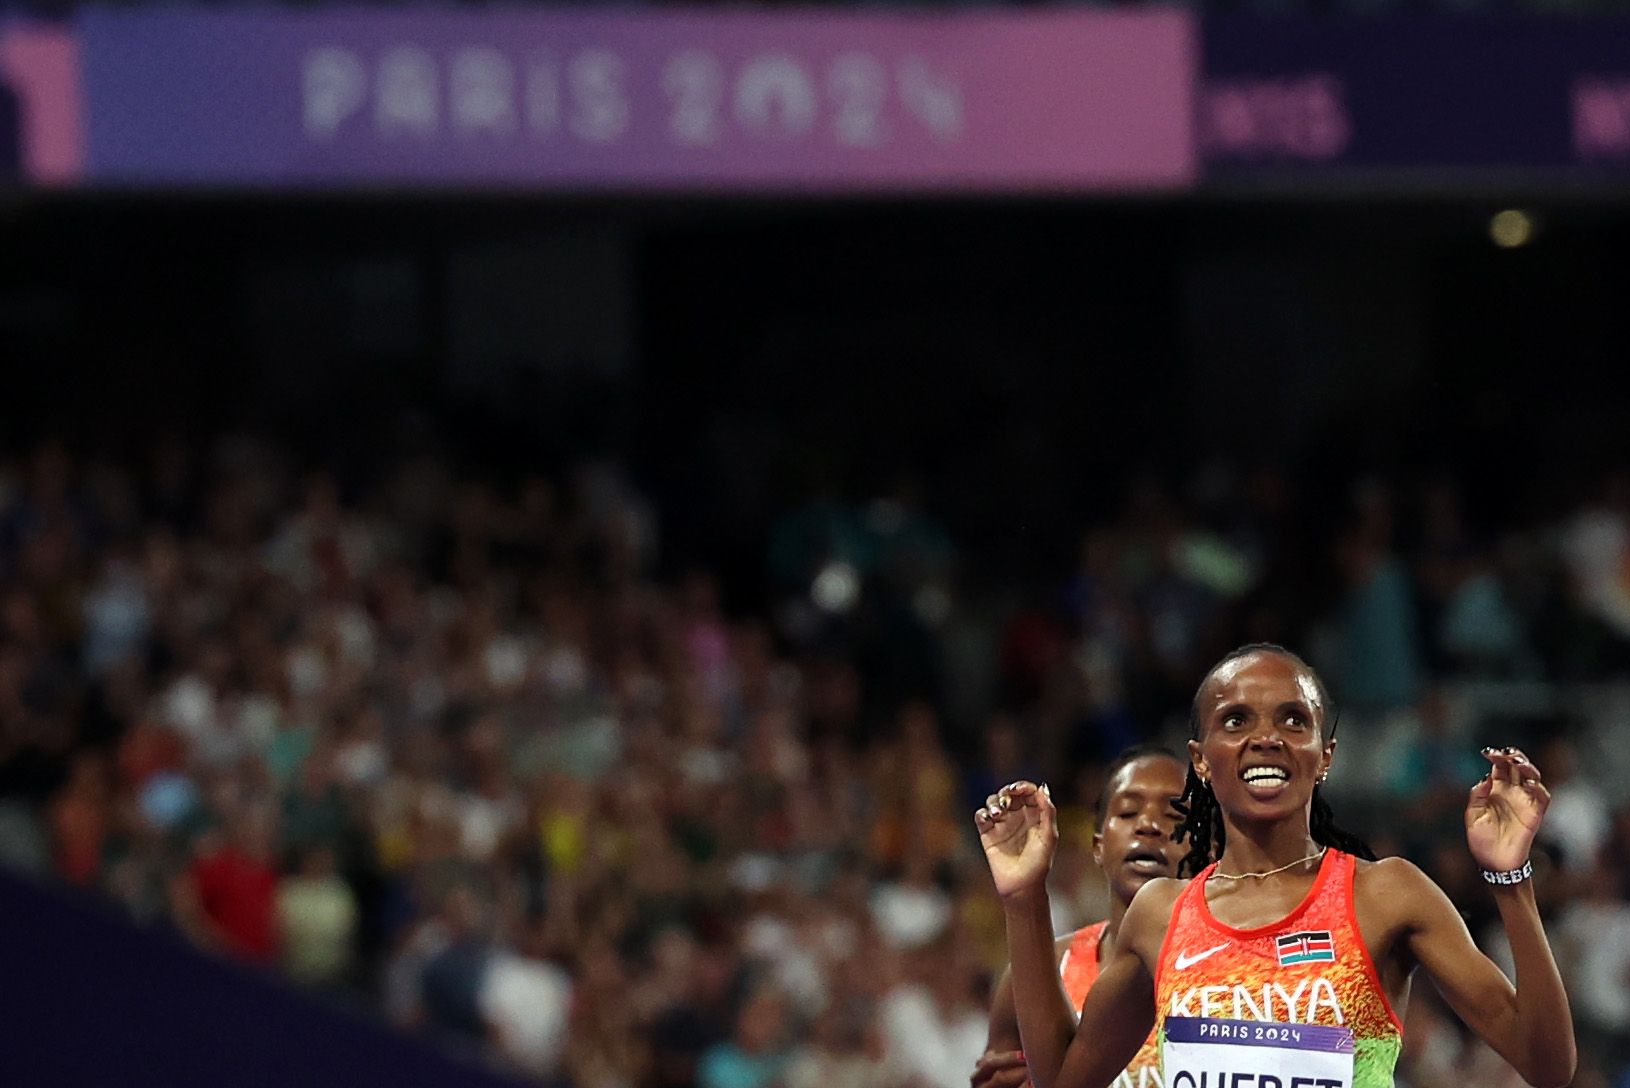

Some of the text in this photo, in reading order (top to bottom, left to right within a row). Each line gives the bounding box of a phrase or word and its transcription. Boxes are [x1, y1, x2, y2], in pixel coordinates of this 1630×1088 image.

[303, 44, 965, 150] PARIS 2024
[1170, 978, 1344, 1024] KENYA
[1200, 1023, 1300, 1042] PARIS 2024
